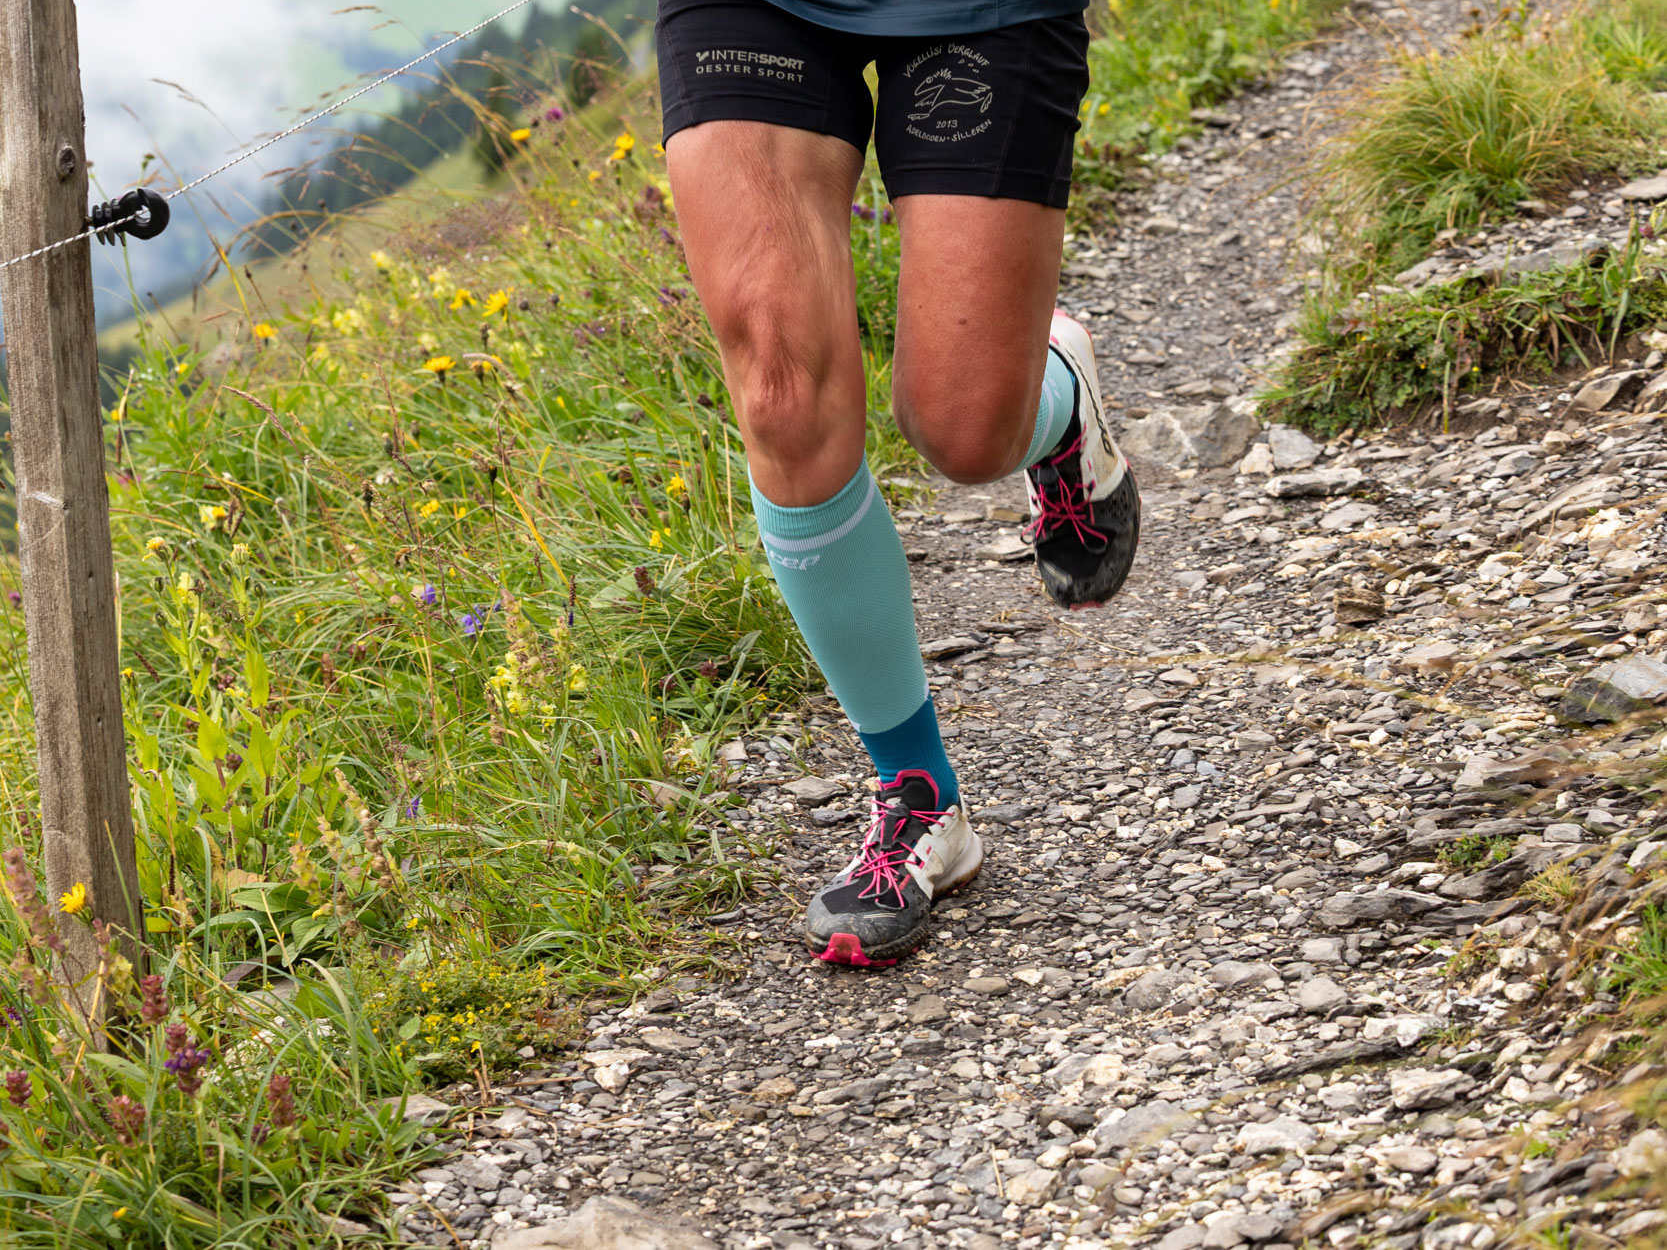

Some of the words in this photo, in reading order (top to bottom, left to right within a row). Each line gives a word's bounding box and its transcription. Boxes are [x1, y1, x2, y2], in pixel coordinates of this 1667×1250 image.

[711, 49, 805, 71] INTERSPORT
[695, 63, 752, 75] OESTER
[757, 67, 804, 83] SPORT
[936, 119, 959, 129] 2013
